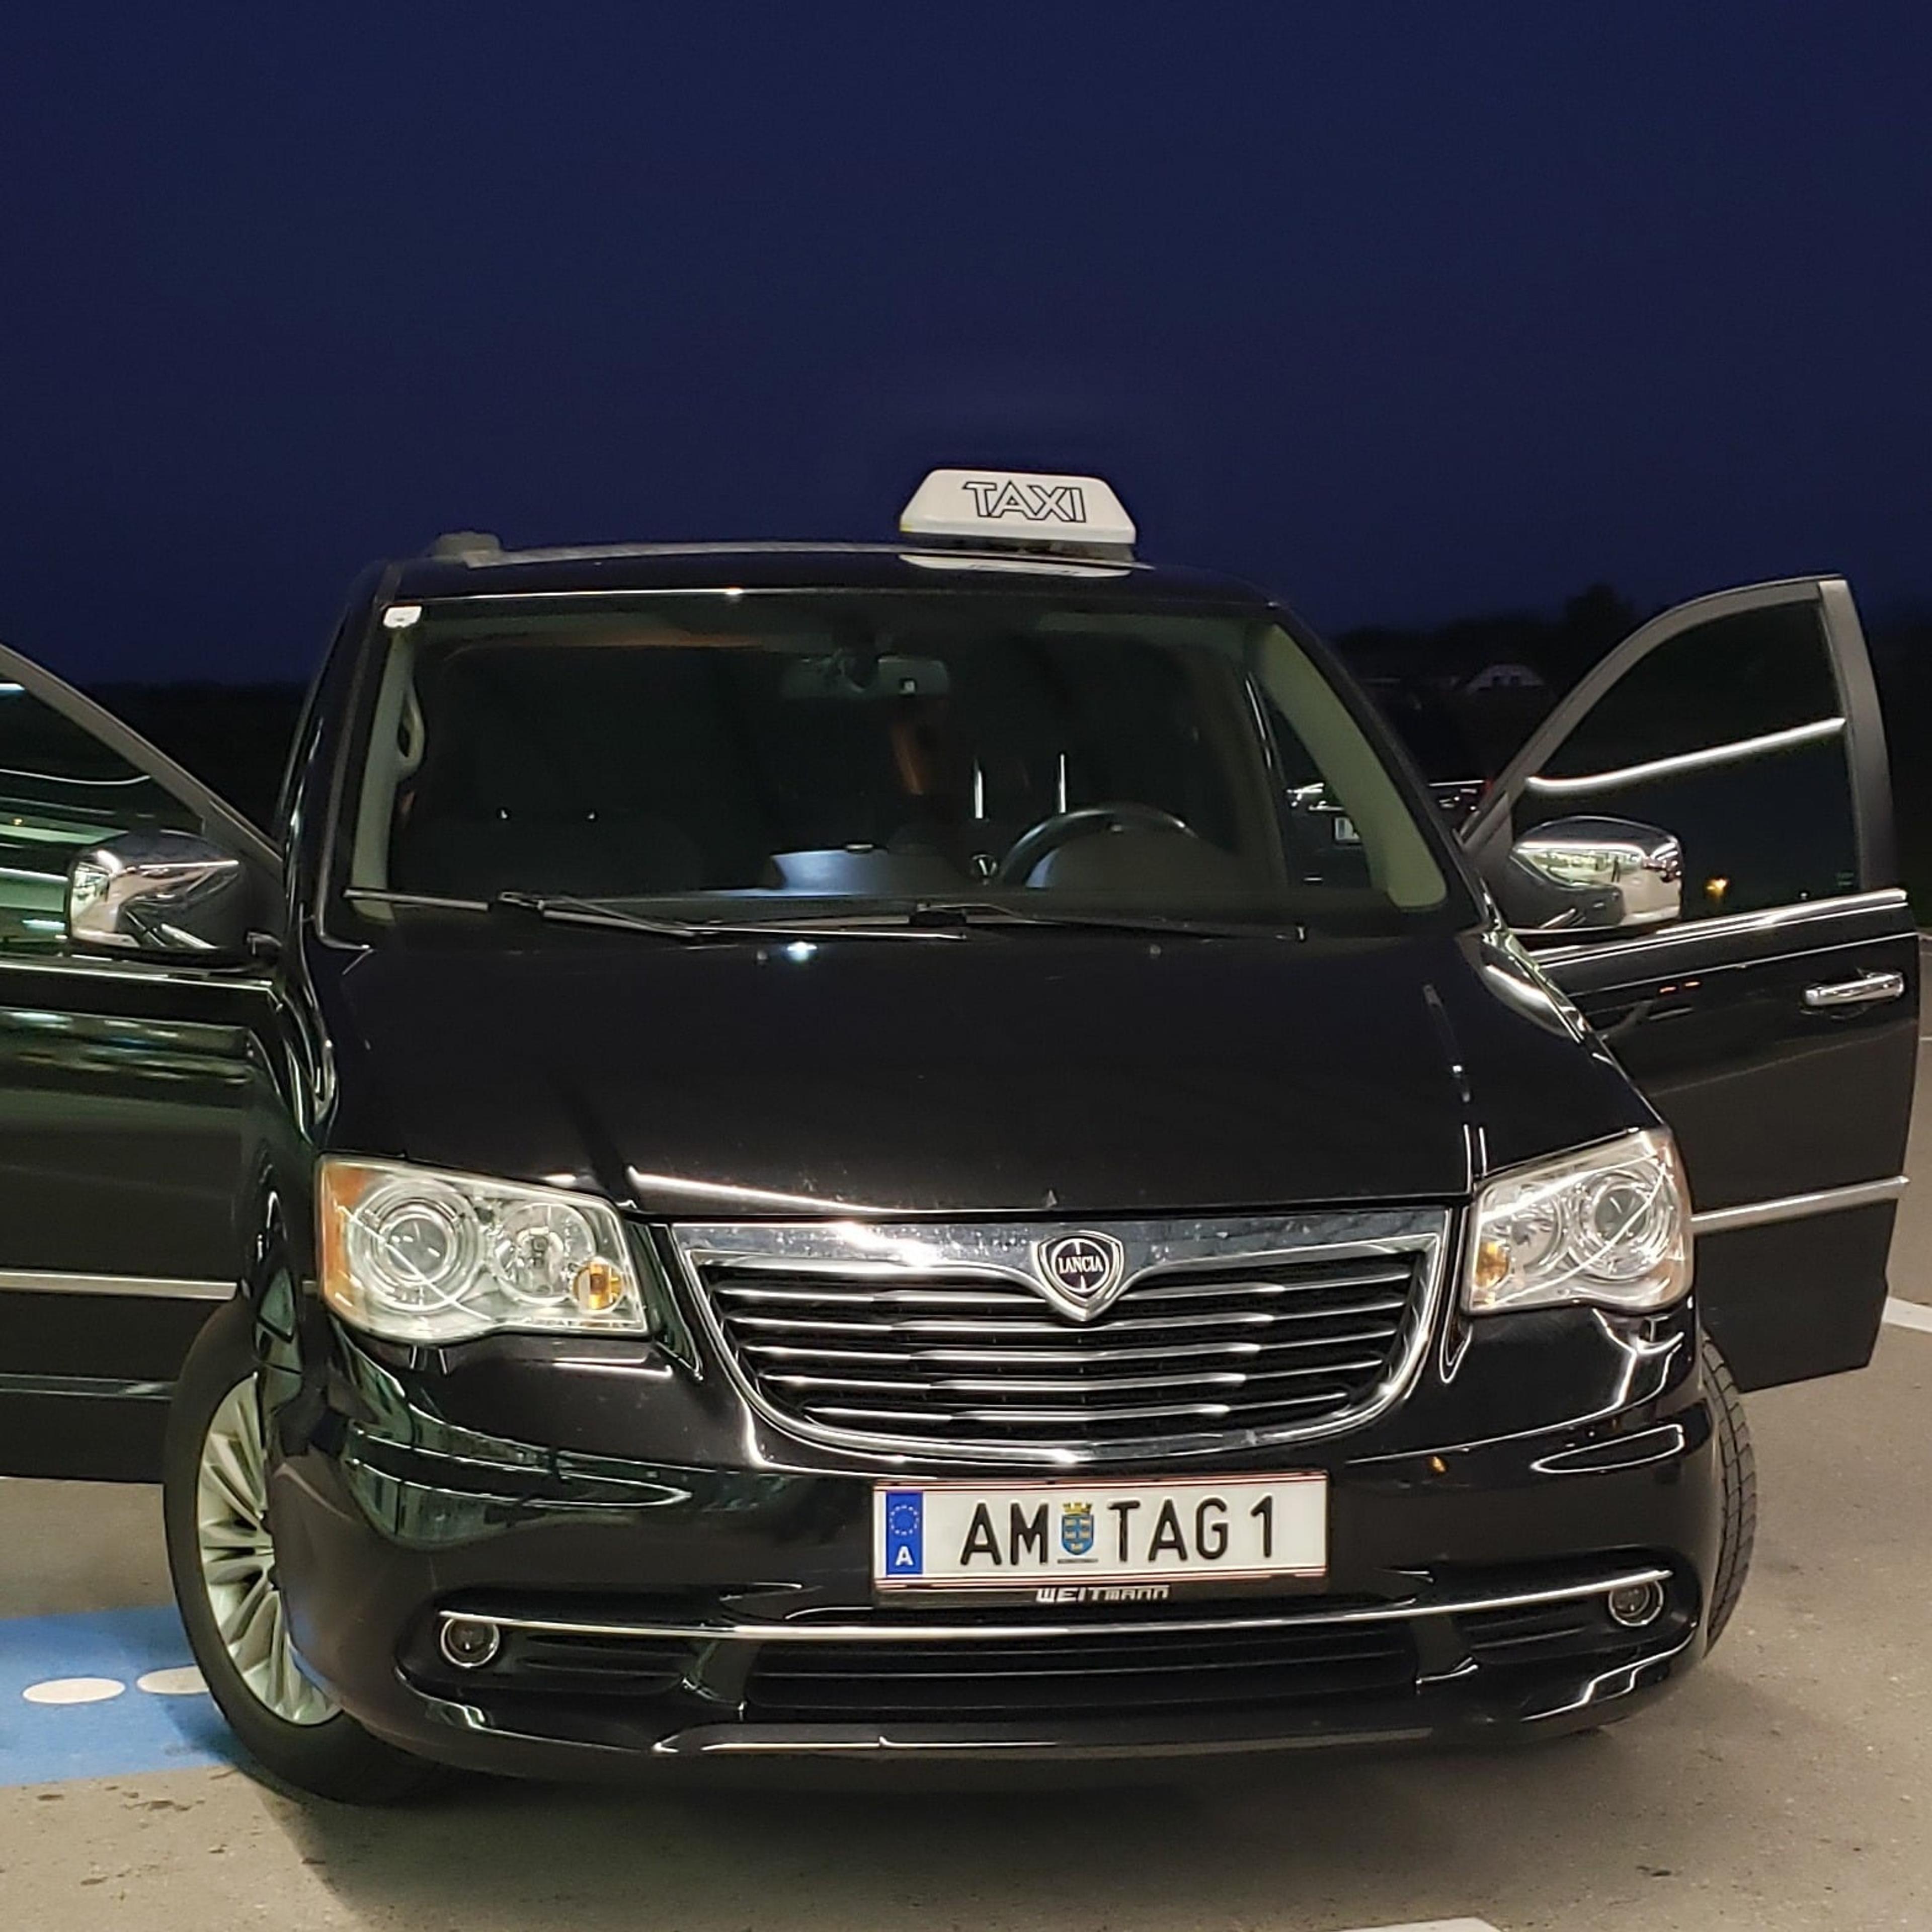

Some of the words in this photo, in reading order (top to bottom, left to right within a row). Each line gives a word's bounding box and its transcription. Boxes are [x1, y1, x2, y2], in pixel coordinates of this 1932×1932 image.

[962, 479, 1086, 523] TAXI
[1058, 1255, 1103, 1274] LANCIA
[960, 1502, 1049, 1565] AM
[1107, 1495, 1229, 1562] TAG
[1251, 1495, 1273, 1558] 1
[895, 1546, 913, 1566] A
